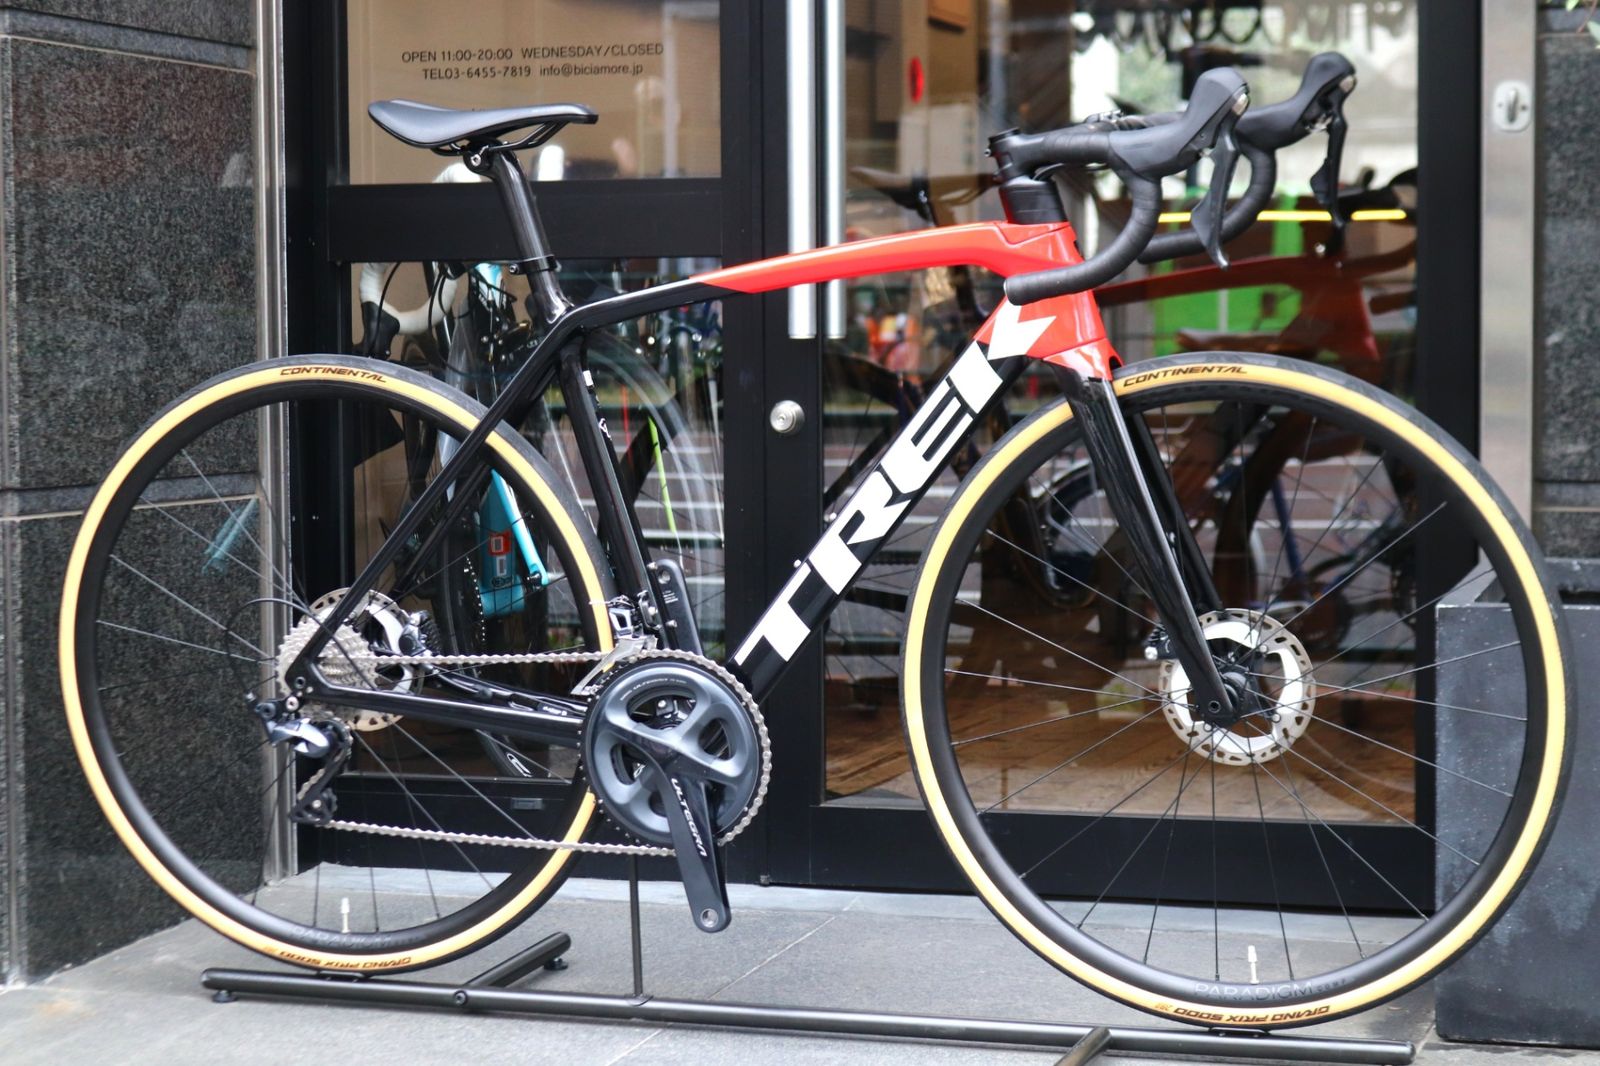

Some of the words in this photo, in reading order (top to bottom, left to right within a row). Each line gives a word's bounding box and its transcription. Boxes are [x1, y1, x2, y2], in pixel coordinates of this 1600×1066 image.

[401, 50, 437, 63] OPEN
[441, 48, 513, 62] 11:00-20:00
[521, 43, 664, 59] WEDNESDAY/CLOSED
[422, 65, 531, 80] TEL03-6455-7819
[540, 63, 643, 77] info@biciamore.jp
[280, 366, 387, 383] CONTINENTAL
[1123, 365, 1248, 388] CONTINENTAL
[735, 299, 1057, 667] TREK
[670, 777, 708, 858] ULTEGRA
[1173, 1006, 1225, 1022] 5000
[1228, 1013, 1270, 1023] PRIX
[1271, 1005, 1330, 1021] GRAND
